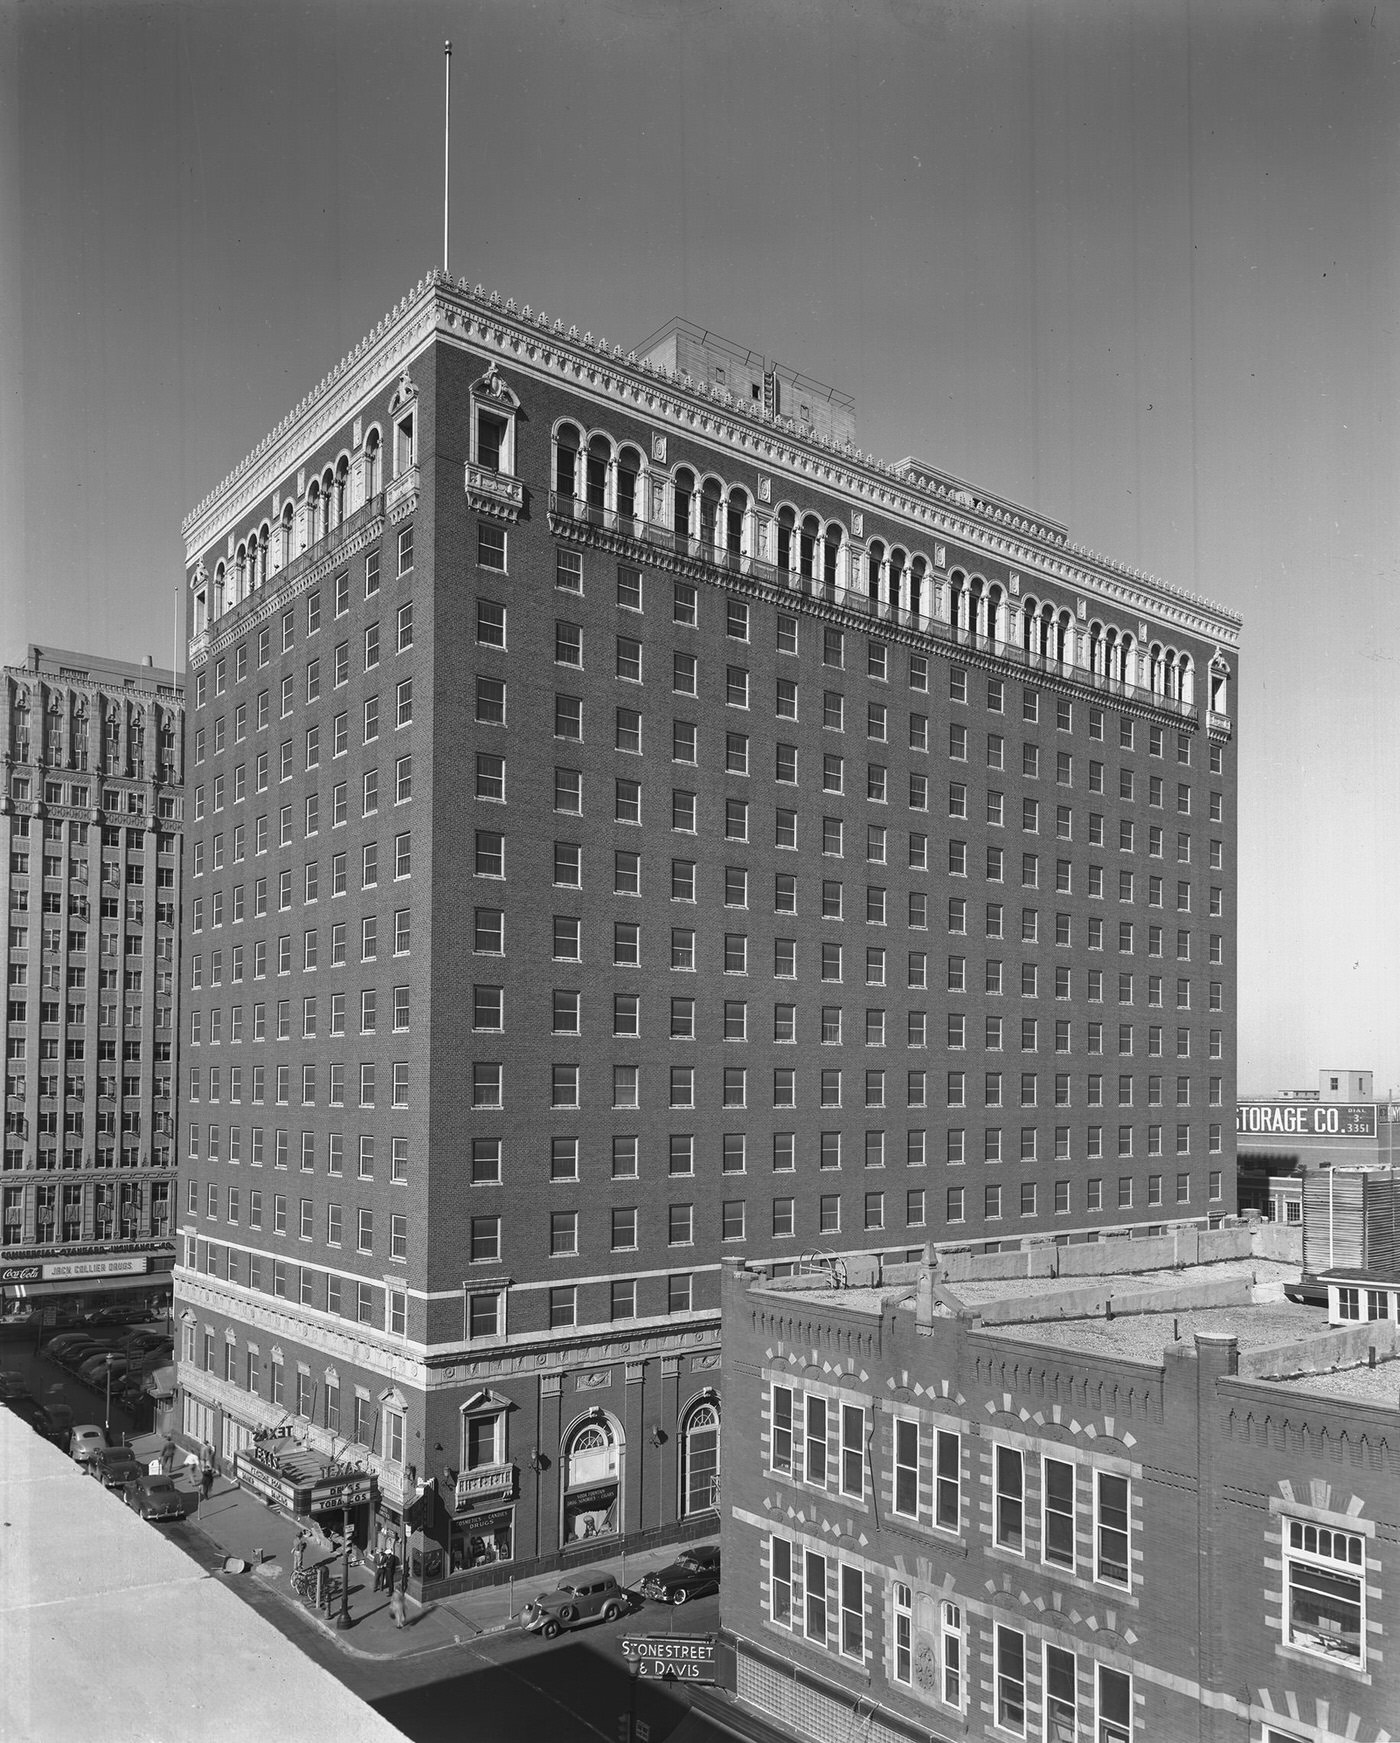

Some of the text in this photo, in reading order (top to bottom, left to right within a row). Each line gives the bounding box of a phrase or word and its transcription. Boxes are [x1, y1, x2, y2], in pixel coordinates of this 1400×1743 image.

[1236, 1107, 1346, 1133] TORAGE CO.
[1347, 1123, 1369, 1133] 3351
[108, 1262, 133, 1272] DRUGS
[320, 1460, 363, 1479] TEXAS
[469, 1520, 494, 1530] DRUGS
[622, 1641, 714, 1659] STONESTREET
[639, 1661, 700, 1677] & DAVIS
